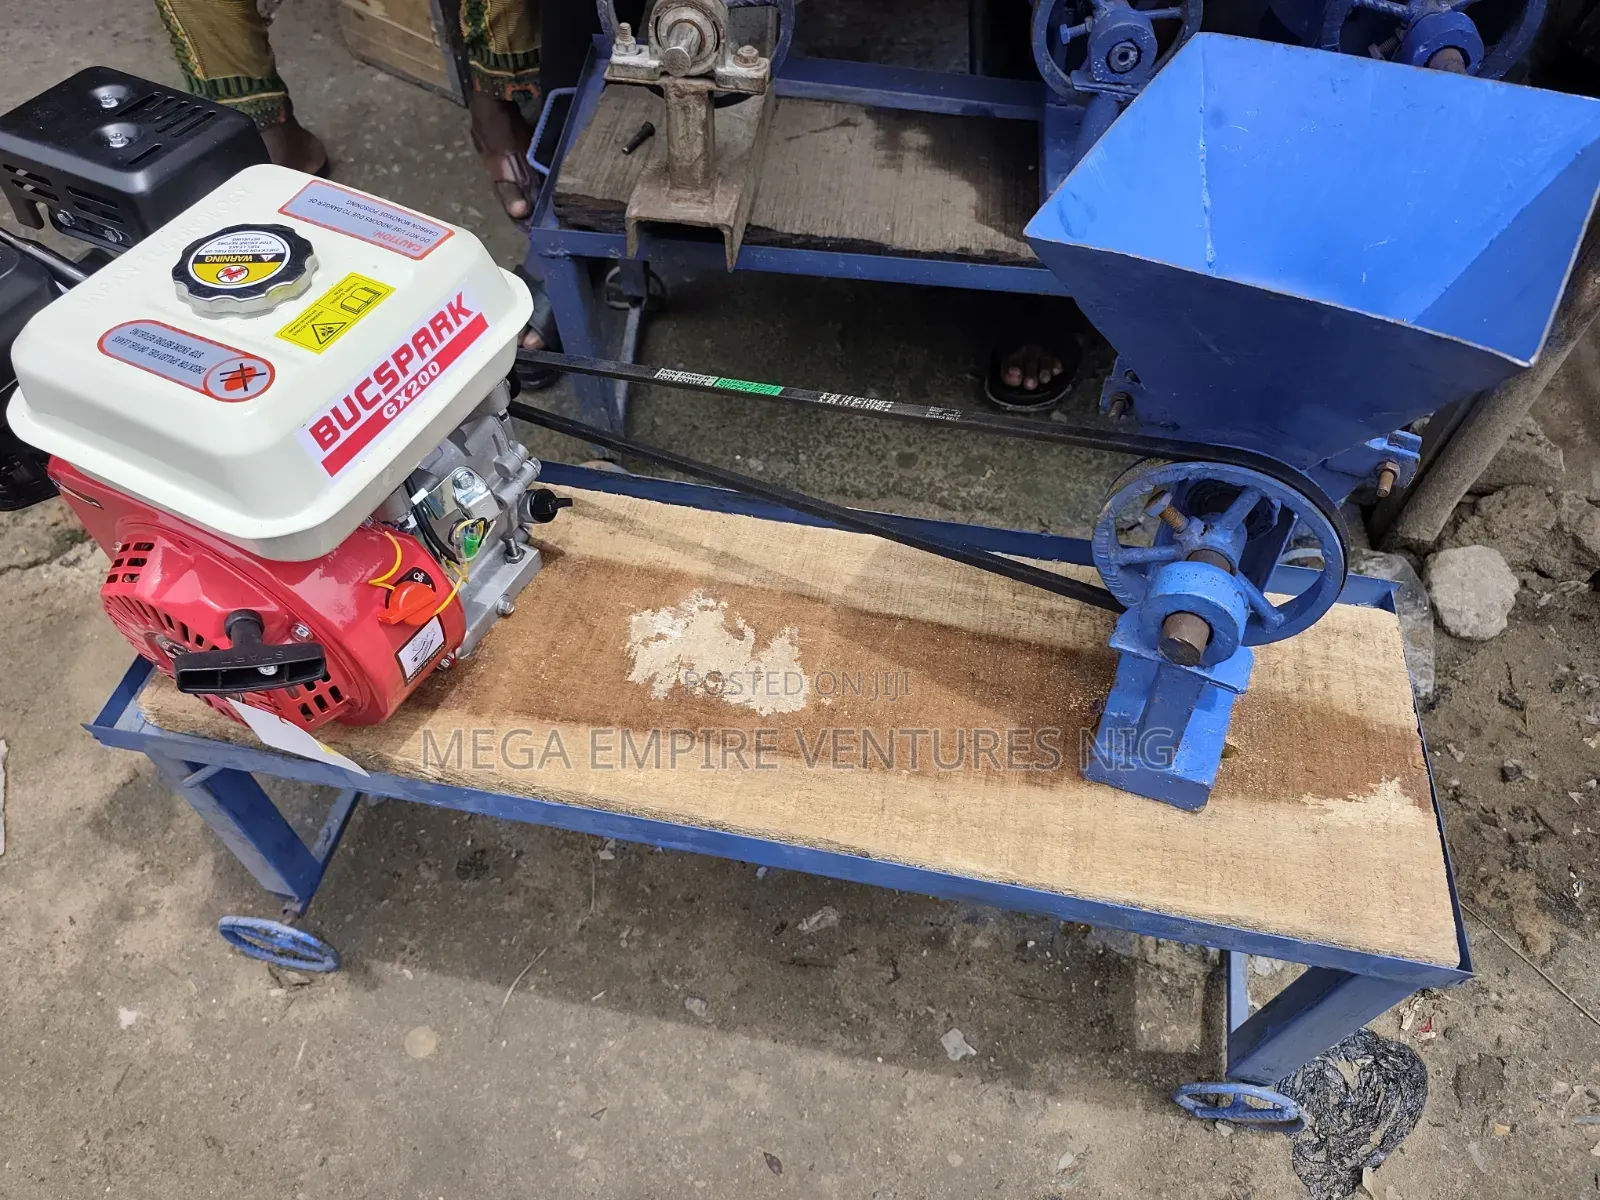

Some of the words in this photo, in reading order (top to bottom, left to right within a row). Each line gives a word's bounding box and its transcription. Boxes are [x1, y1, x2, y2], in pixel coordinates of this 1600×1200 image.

[316, 201, 343, 213] DANGER
[345, 199, 380, 215] POISONING
[352, 212, 365, 220] DUE
[379, 210, 412, 226] MONOXIDE
[365, 217, 392, 230] INDOORS
[392, 226, 406, 234] USE
[405, 231, 420, 240] NOT
[412, 224, 439, 236] CARBON
[204, 255, 253, 263] WARNING
[148, 348, 161, 359] FUEL
[309, 291, 474, 452] BUCSPARK
[382, 361, 441, 420] GX200
